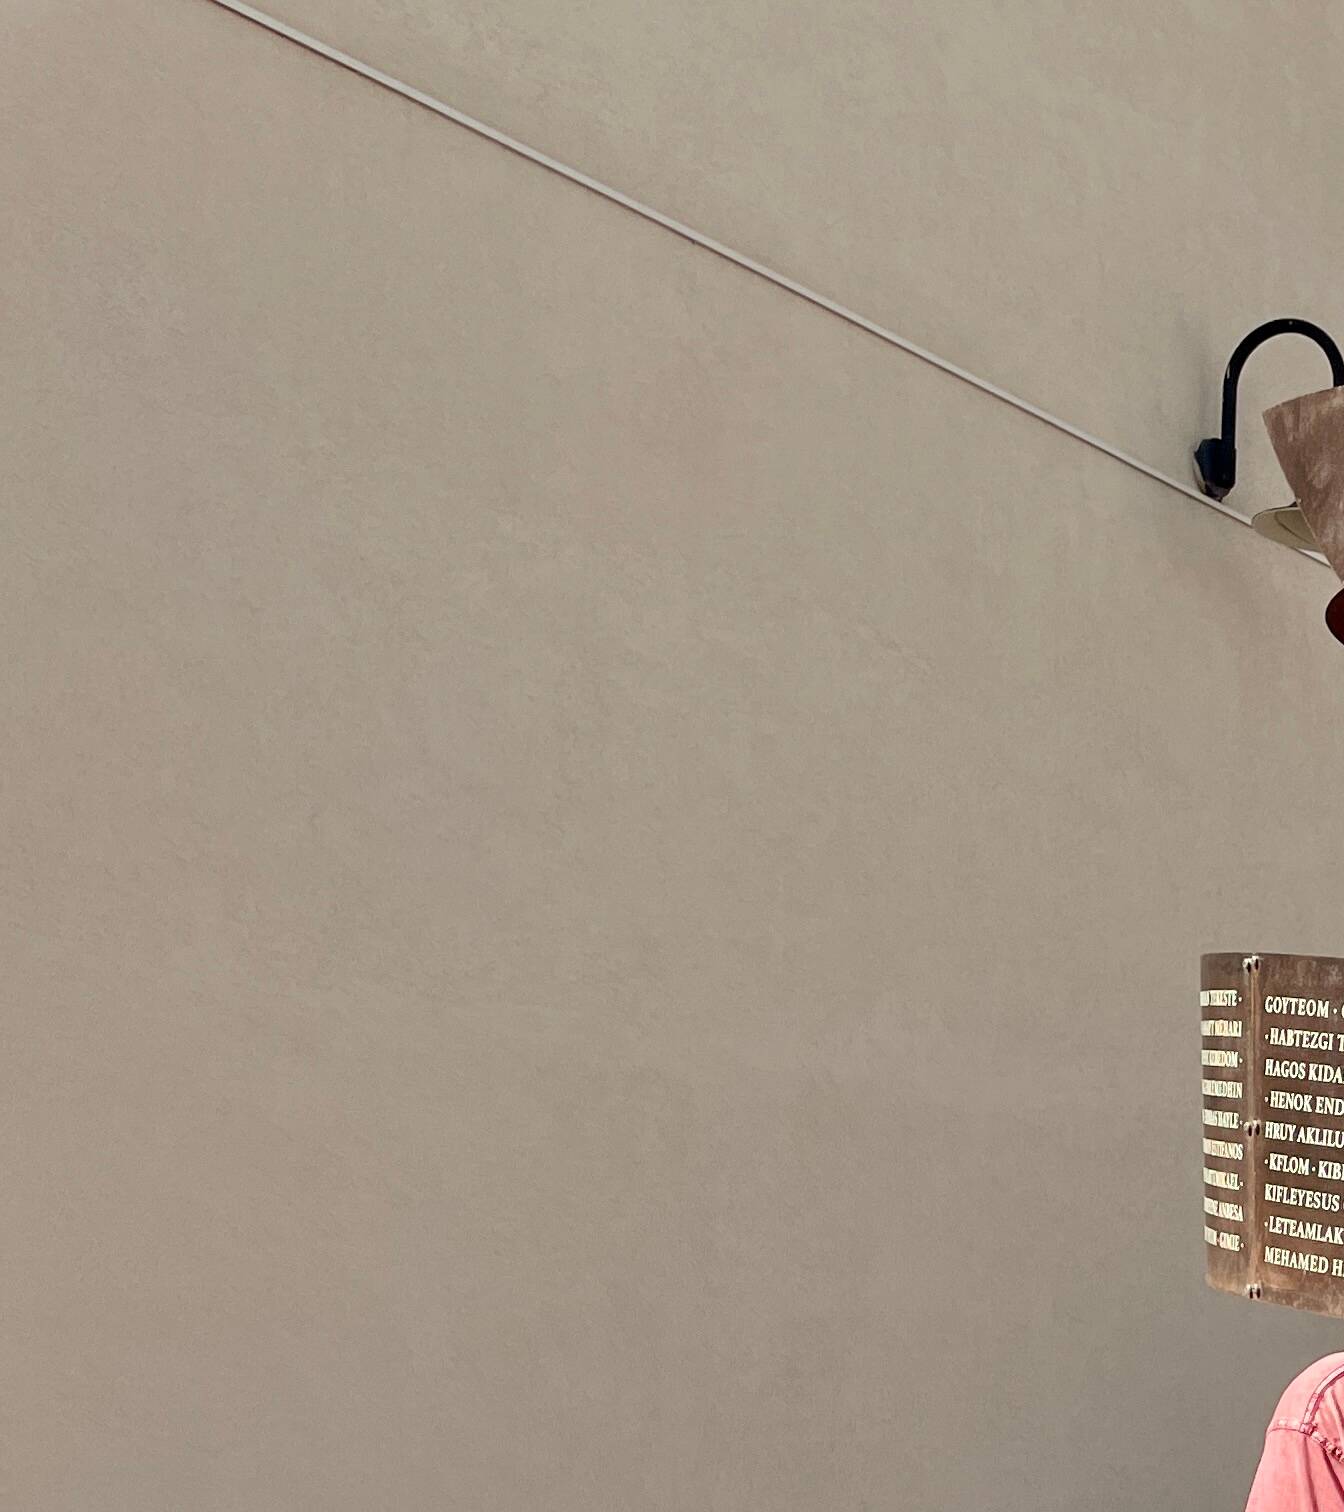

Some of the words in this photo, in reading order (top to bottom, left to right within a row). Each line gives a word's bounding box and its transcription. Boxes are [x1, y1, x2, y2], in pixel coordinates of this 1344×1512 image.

[1265, 996, 1329, 1018] GOYTEOM
[1270, 1028, 1334, 1050] HABTEZGI
[1265, 1059, 1306, 1079] HAGOS
[1270, 1091, 1312, 1112] HENOK
[1269, 1153, 1309, 1175] KFLOM
[1265, 1184, 1340, 1212] KIFLEYESUS
[1269, 1216, 1344, 1244] LETEAMLAK
[1264, 1246, 1328, 1273] MEHAMED
